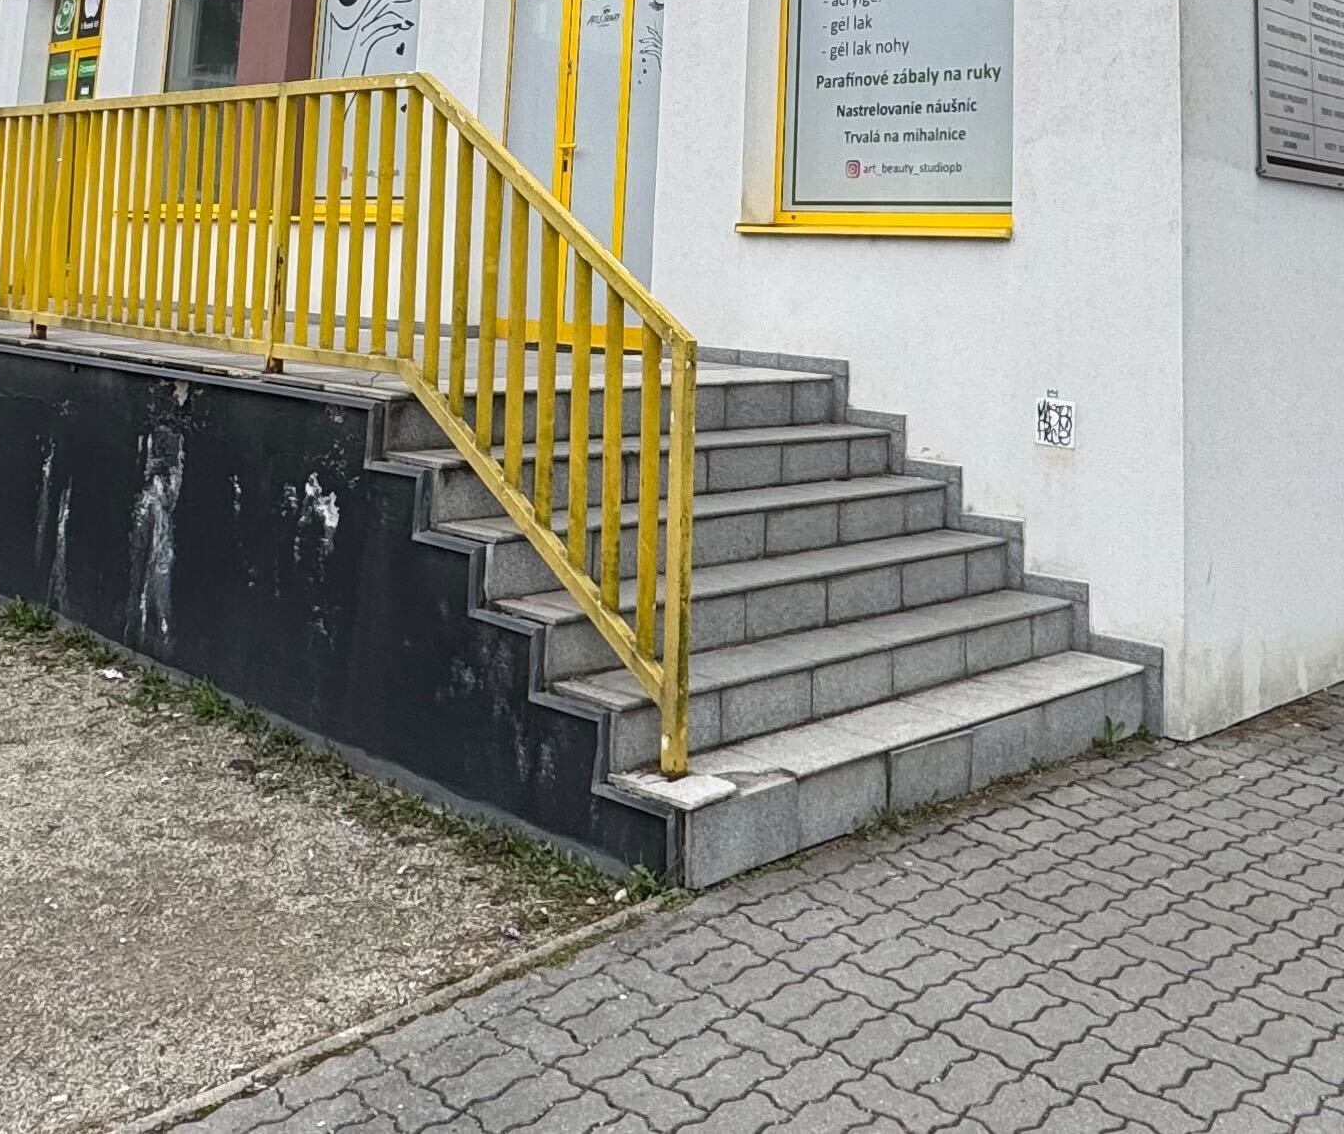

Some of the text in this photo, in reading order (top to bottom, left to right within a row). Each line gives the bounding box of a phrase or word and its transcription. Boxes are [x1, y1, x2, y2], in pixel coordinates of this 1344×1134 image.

[853, 14, 873, 30] lak
[853, 40, 872, 56] lak
[875, 37, 910, 55] nohy
[892, 66, 939, 86] zábaly
[943, 69, 961, 82] na
[966, 62, 1001, 82] ruky
[836, 102, 922, 118] Nastrelovanie
[844, 127, 966, 144] Trvalá na mihalnice
